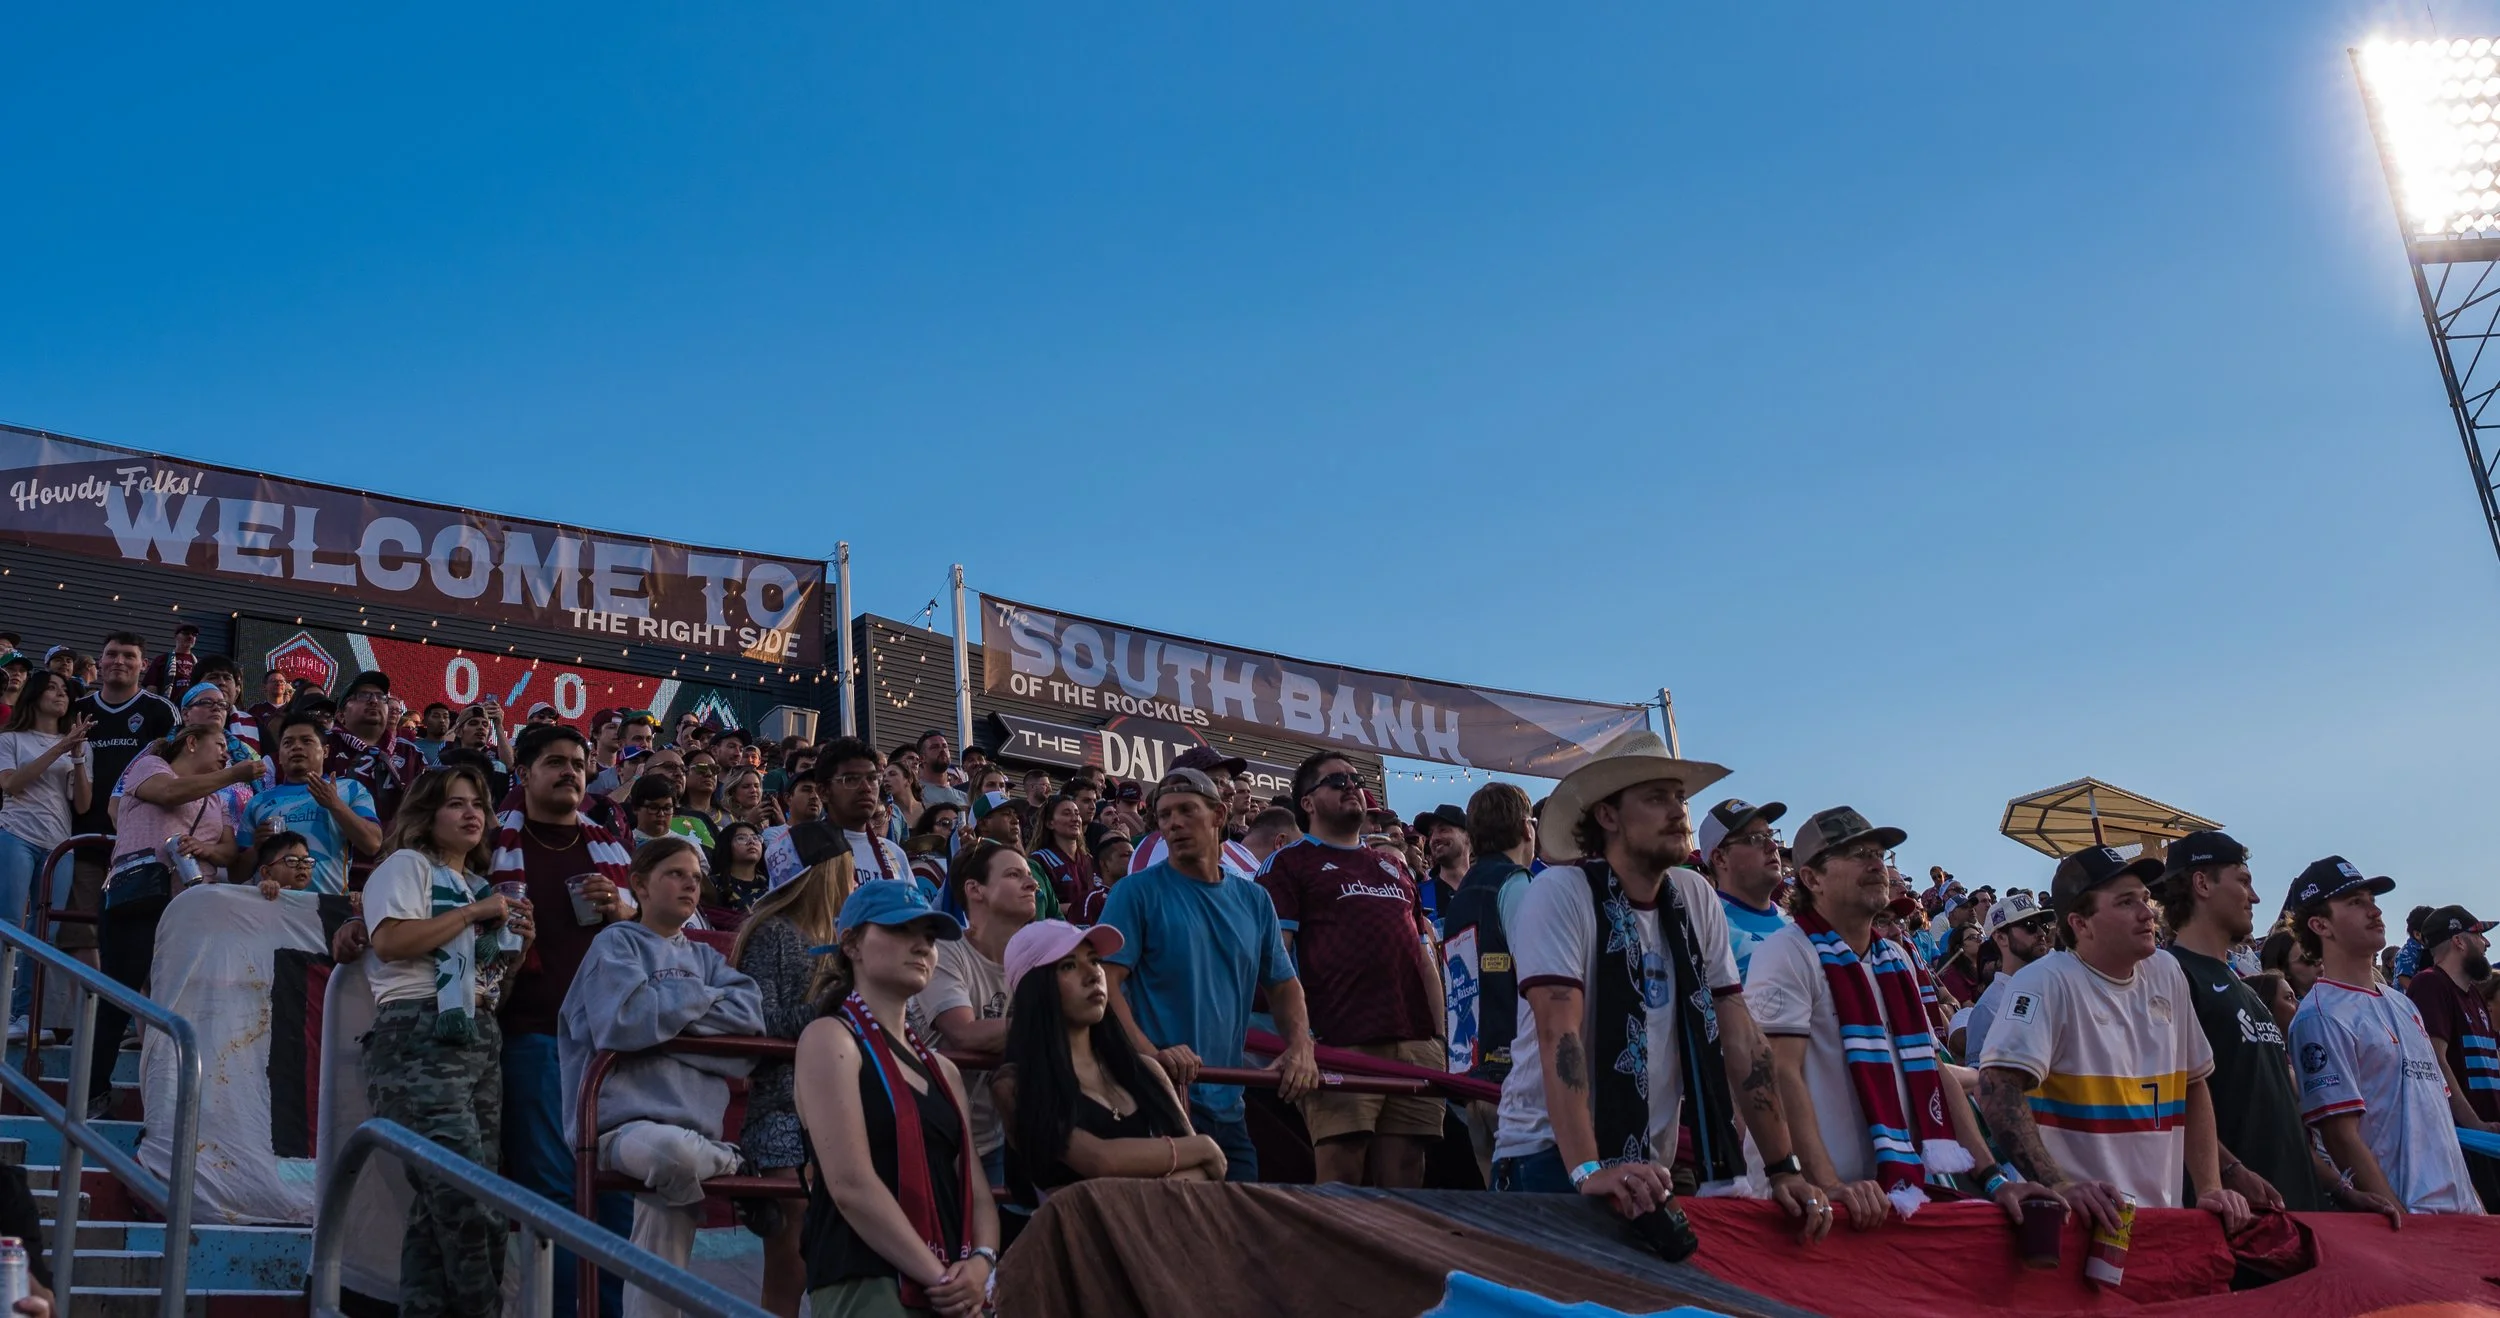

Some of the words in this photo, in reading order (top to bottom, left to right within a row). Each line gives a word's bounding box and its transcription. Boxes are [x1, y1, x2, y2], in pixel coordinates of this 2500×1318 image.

[10, 475, 111, 512] Howdy
[115, 462, 204, 496] Folks!
[104, 486, 653, 619] WELCOME
[687, 553, 805, 632] TO
[569, 607, 629, 635] THE
[638, 616, 731, 647] RIGHT
[738, 626, 801, 658] SIDE
[996, 602, 1030, 627] The
[445, 656, 479, 705] 0
[554, 673, 587, 720] 0
[1010, 610, 1259, 724] SOUTH
[1010, 673, 1043, 697] OF
[1048, 681, 1097, 708] THE
[1104, 691, 1210, 727] ROCKIES
[1019, 729, 1082, 756] THE
[1340, 879, 1406, 899] uchealth
[2140, 1082, 2160, 1130] 7
